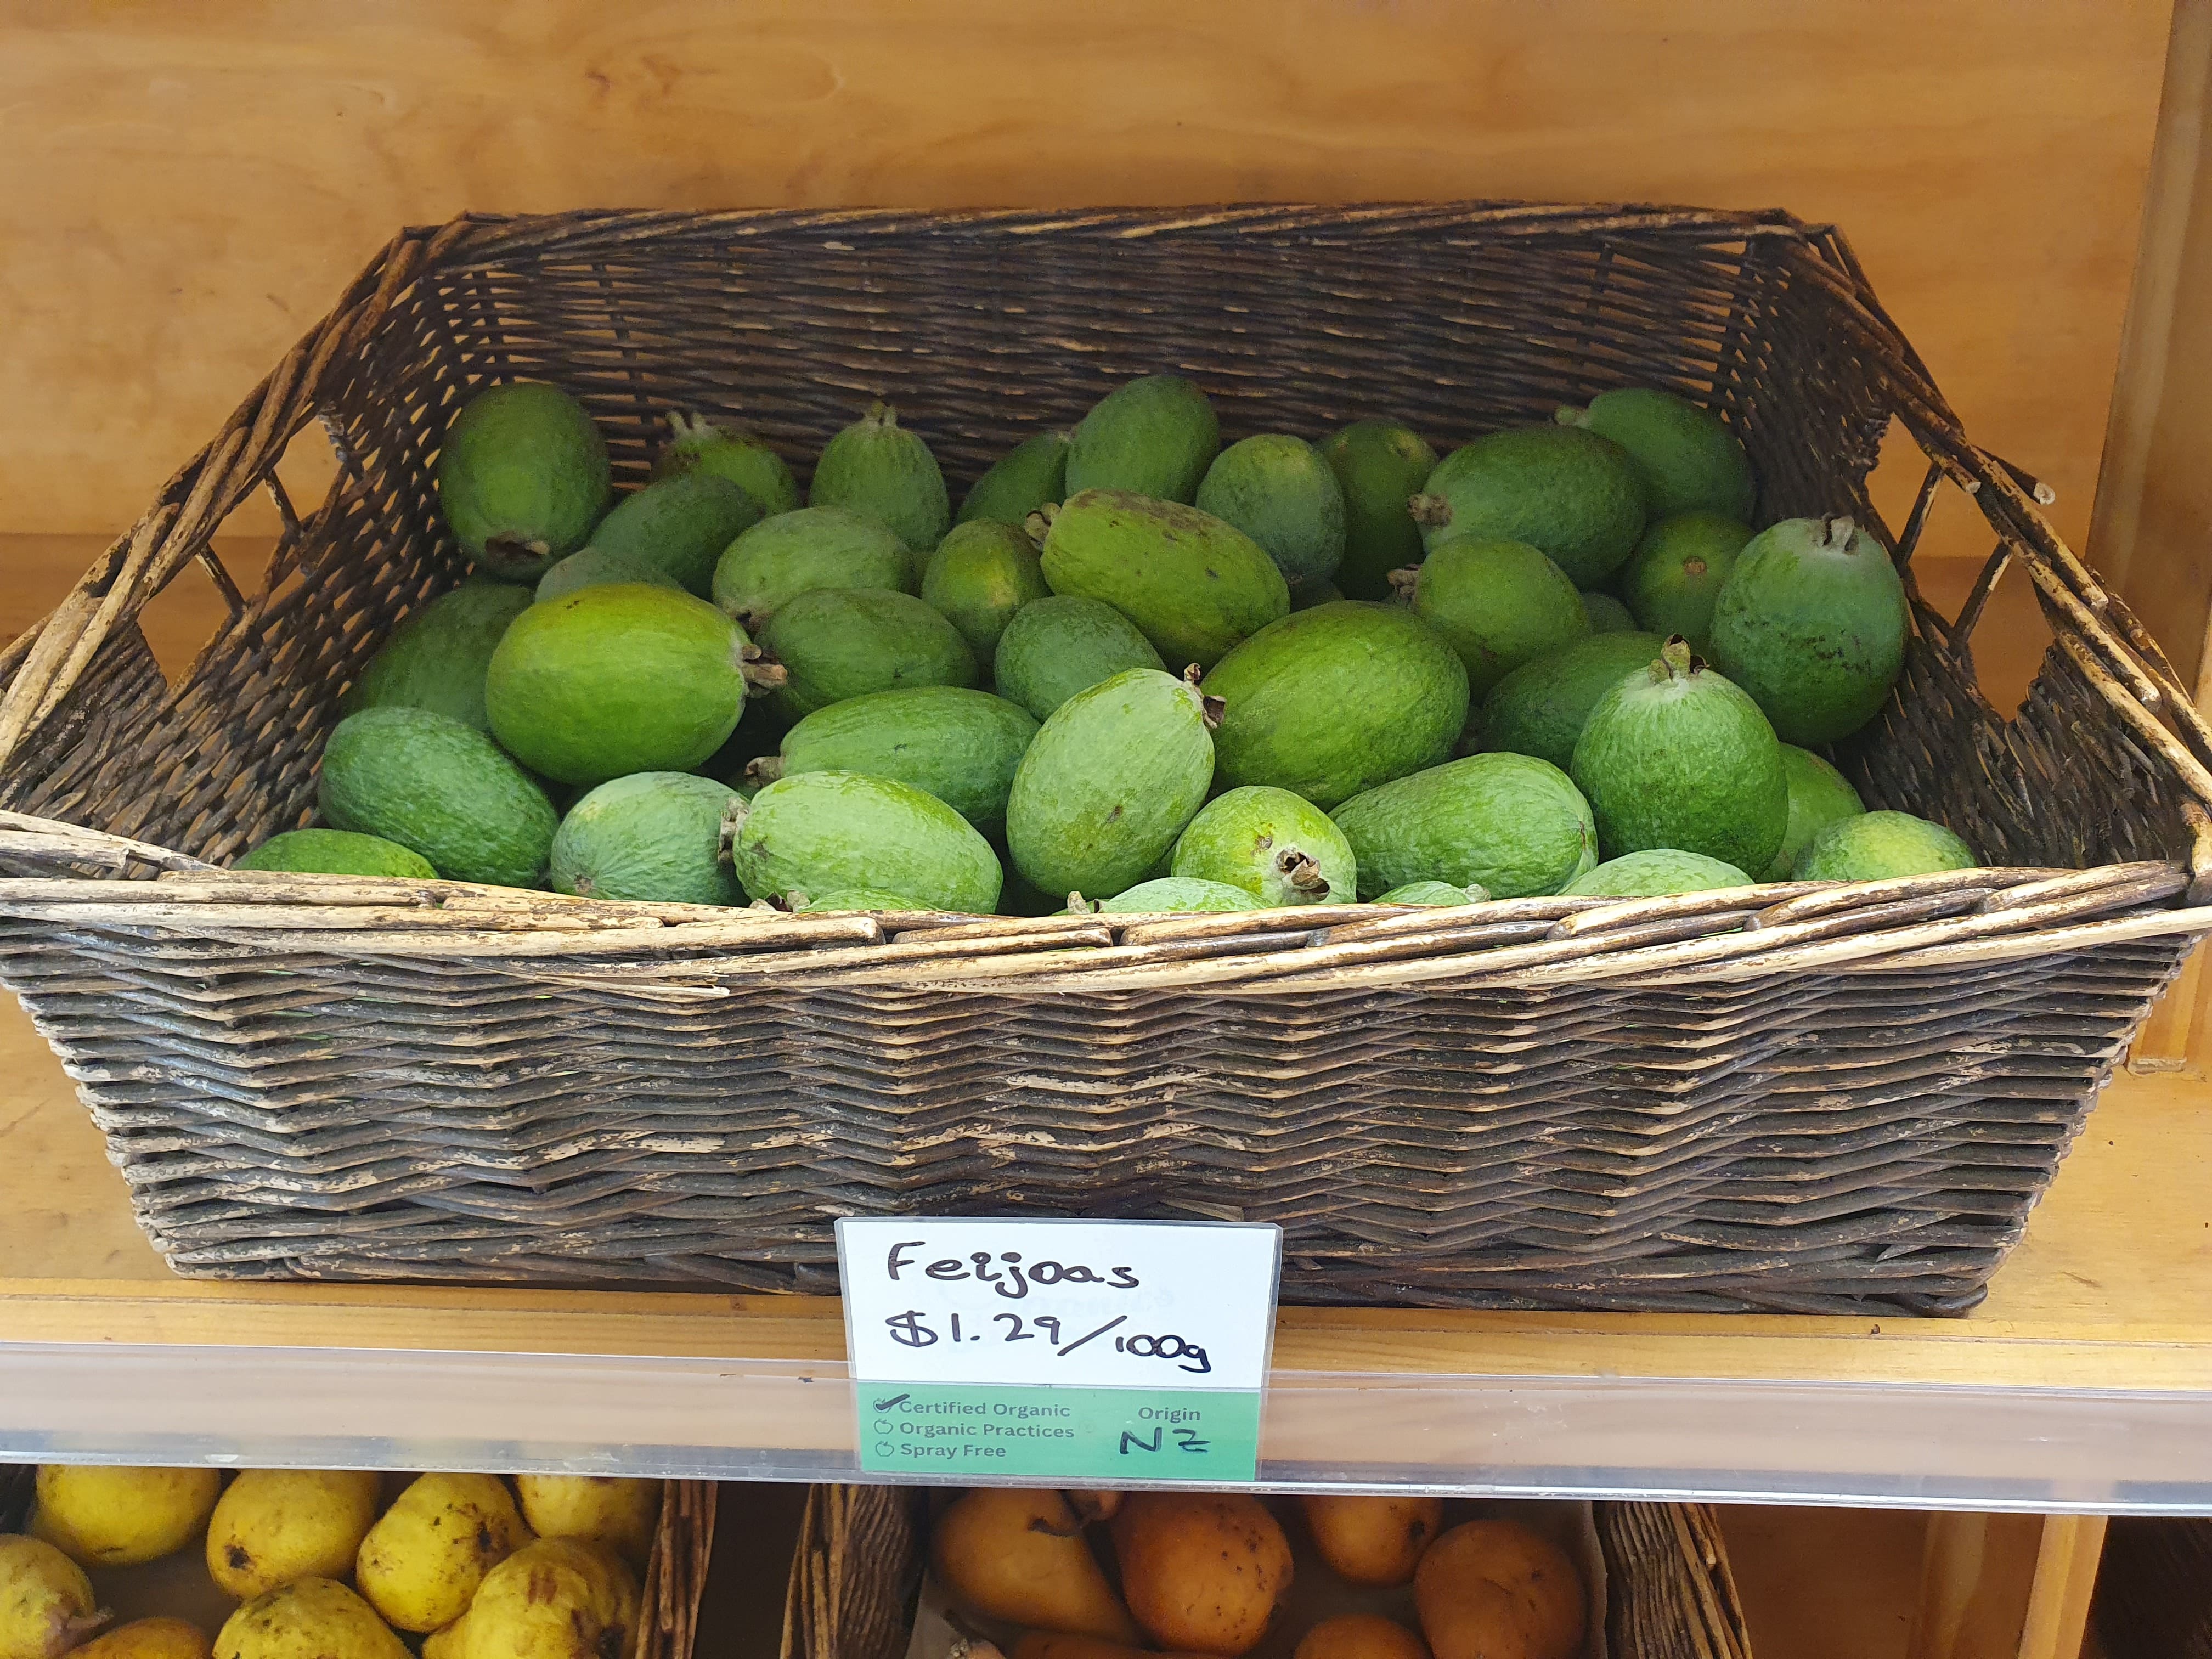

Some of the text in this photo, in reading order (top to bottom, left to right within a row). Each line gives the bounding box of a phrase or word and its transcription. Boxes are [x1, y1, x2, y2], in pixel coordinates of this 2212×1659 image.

[888, 1241, 1139, 1299] Feijoas
[899, 1399, 1071, 1418] Certified Organic
[1138, 1406, 1201, 1423] Origin
[900, 1421, 1075, 1438] Organic Practices
[1119, 1427, 1211, 1454] NZ
[900, 1443, 1006, 1459] Spray Free
